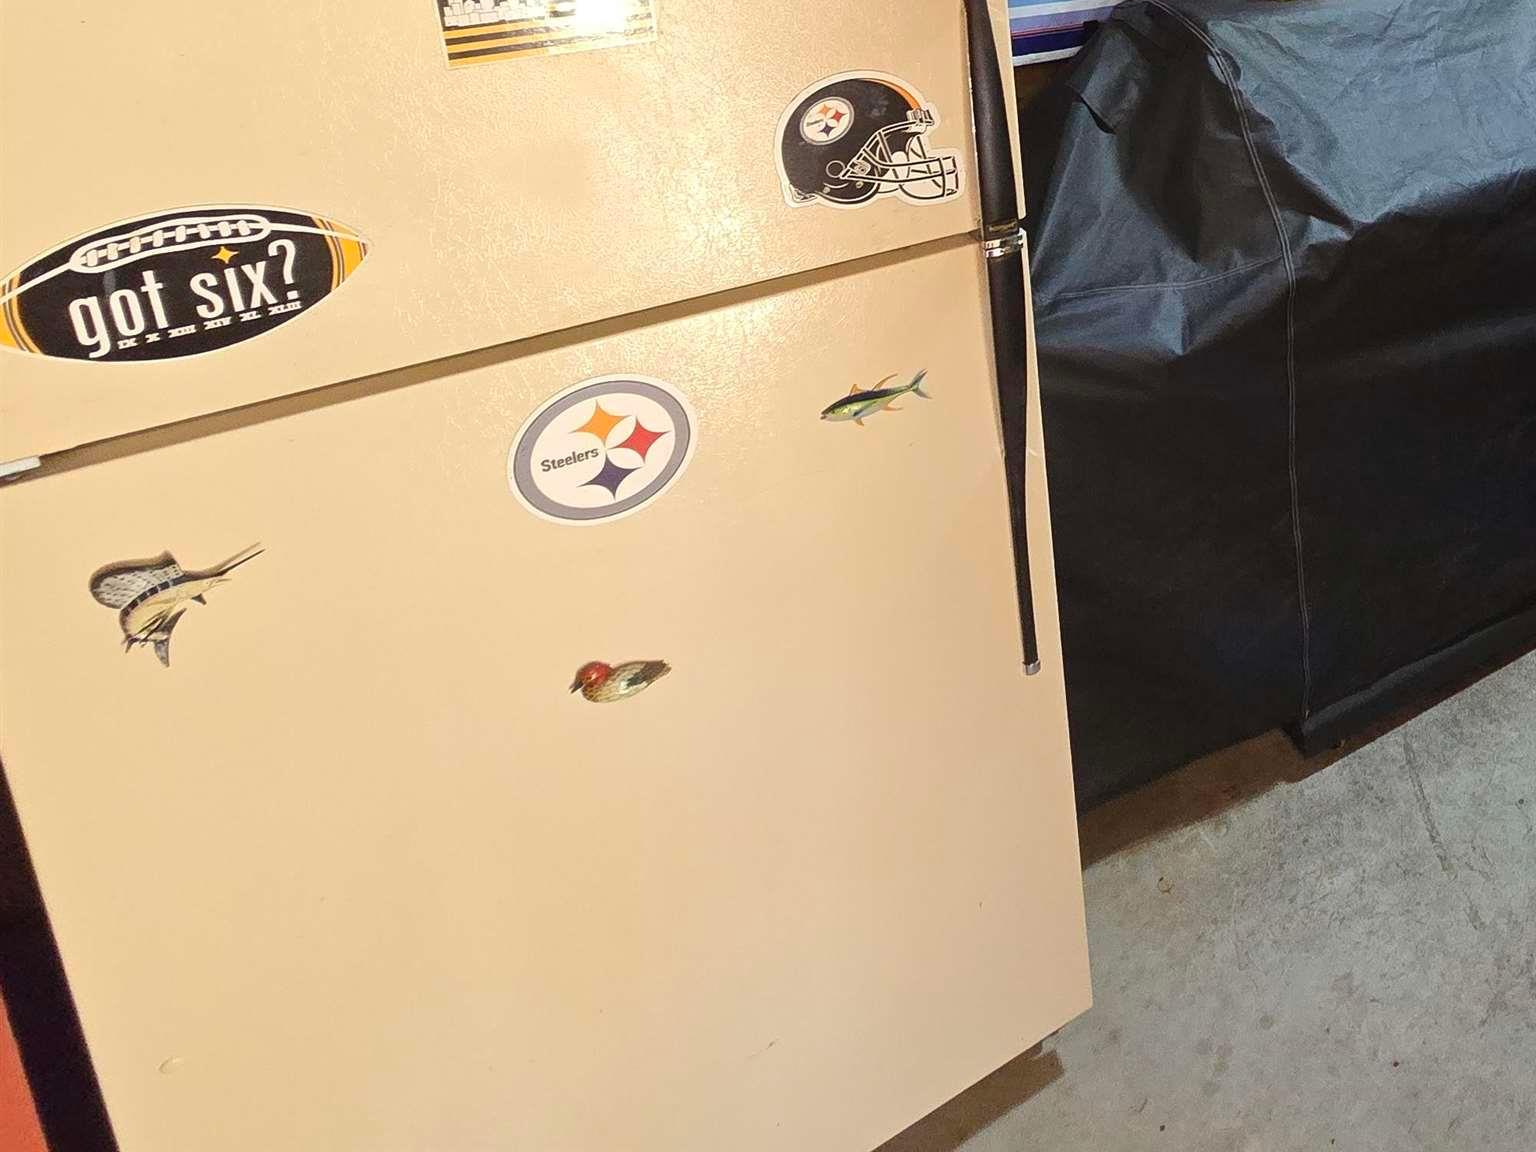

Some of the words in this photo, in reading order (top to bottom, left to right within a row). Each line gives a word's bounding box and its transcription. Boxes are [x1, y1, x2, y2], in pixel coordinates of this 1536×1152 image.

[69, 270, 170, 358] got
[117, 337, 138, 349] IX
[145, 332, 161, 343] X
[203, 316, 232, 330] XIV
[239, 310, 262, 322] XL
[541, 448, 599, 472] Steelers
